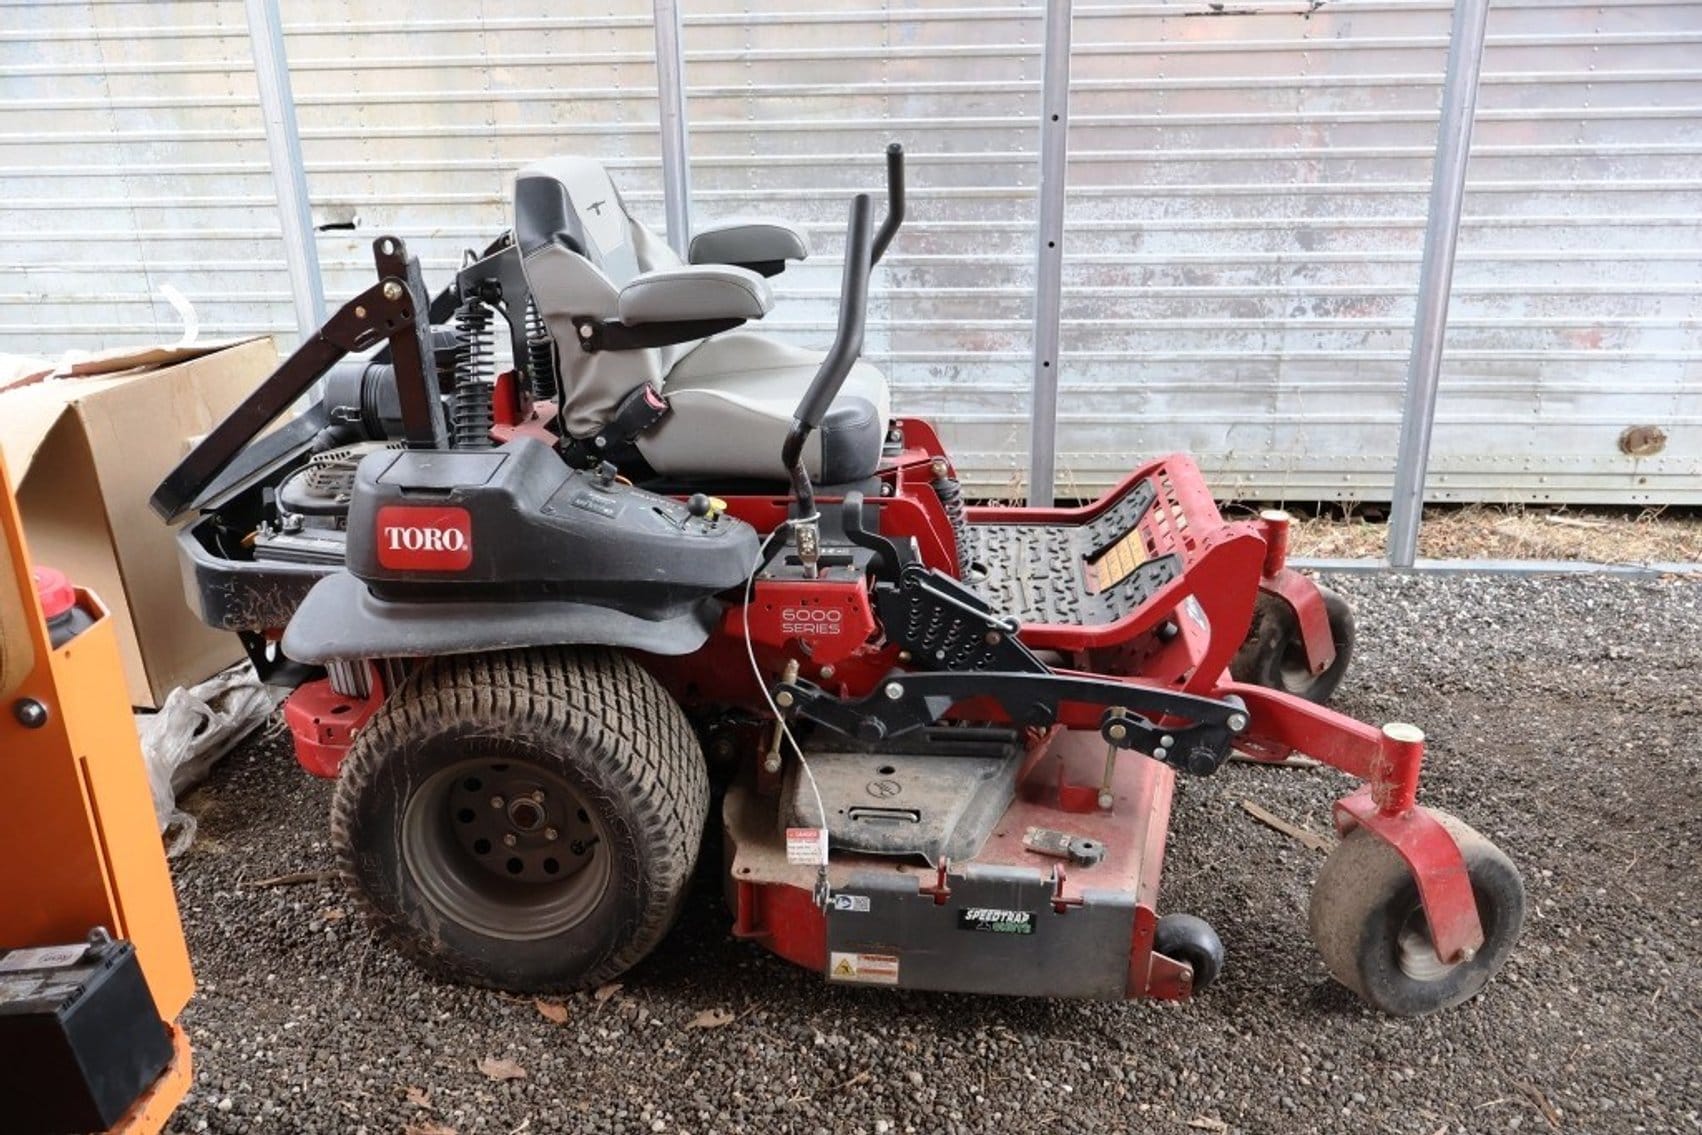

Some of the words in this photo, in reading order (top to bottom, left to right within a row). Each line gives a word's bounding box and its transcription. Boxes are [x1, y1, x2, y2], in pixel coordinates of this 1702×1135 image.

[384, 526, 464, 551] TORO
[782, 609, 841, 622] 6000
[782, 623, 841, 635] SERIES
[965, 908, 1030, 924] SPEEDTRAP
